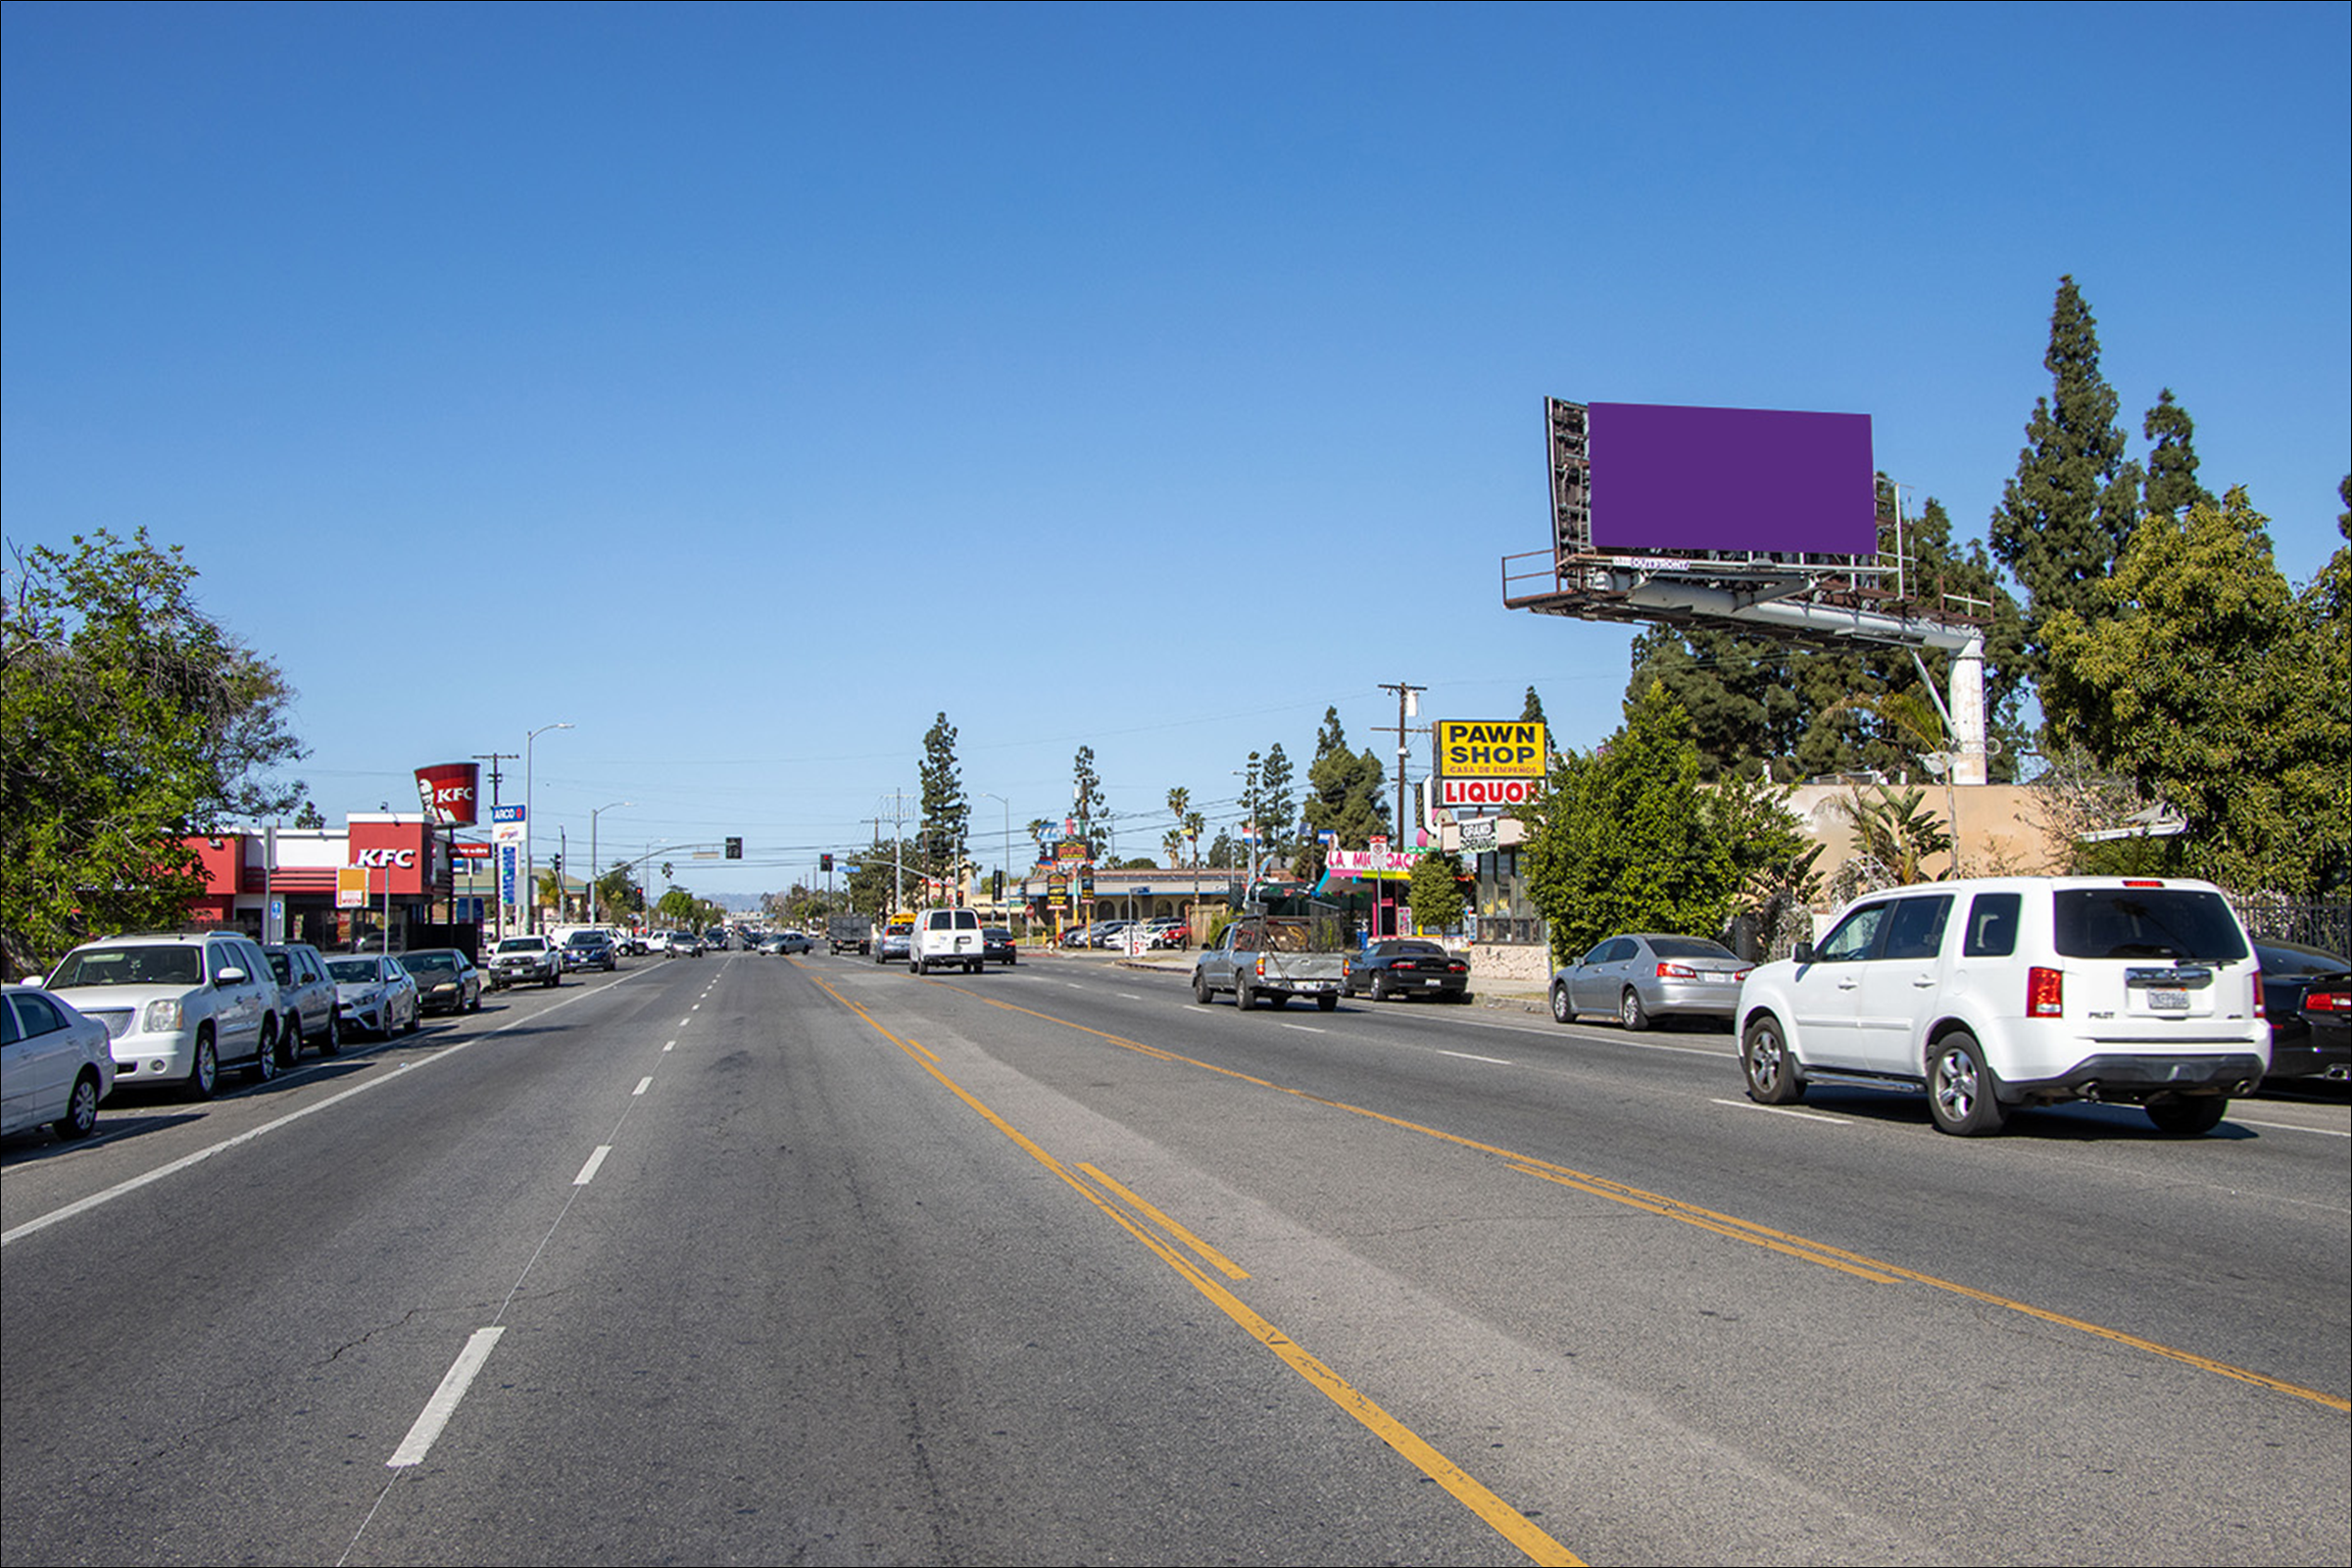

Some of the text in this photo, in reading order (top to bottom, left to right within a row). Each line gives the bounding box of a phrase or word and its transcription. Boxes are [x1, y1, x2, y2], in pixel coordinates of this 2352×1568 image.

[1449, 725, 1536, 743] PAWN
[1449, 746, 1536, 763] SHOP
[436, 787, 473, 803] KFC
[494, 808, 514, 819] ARCO
[355, 849, 416, 868] KFC
[1328, 851, 1345, 866] LA
